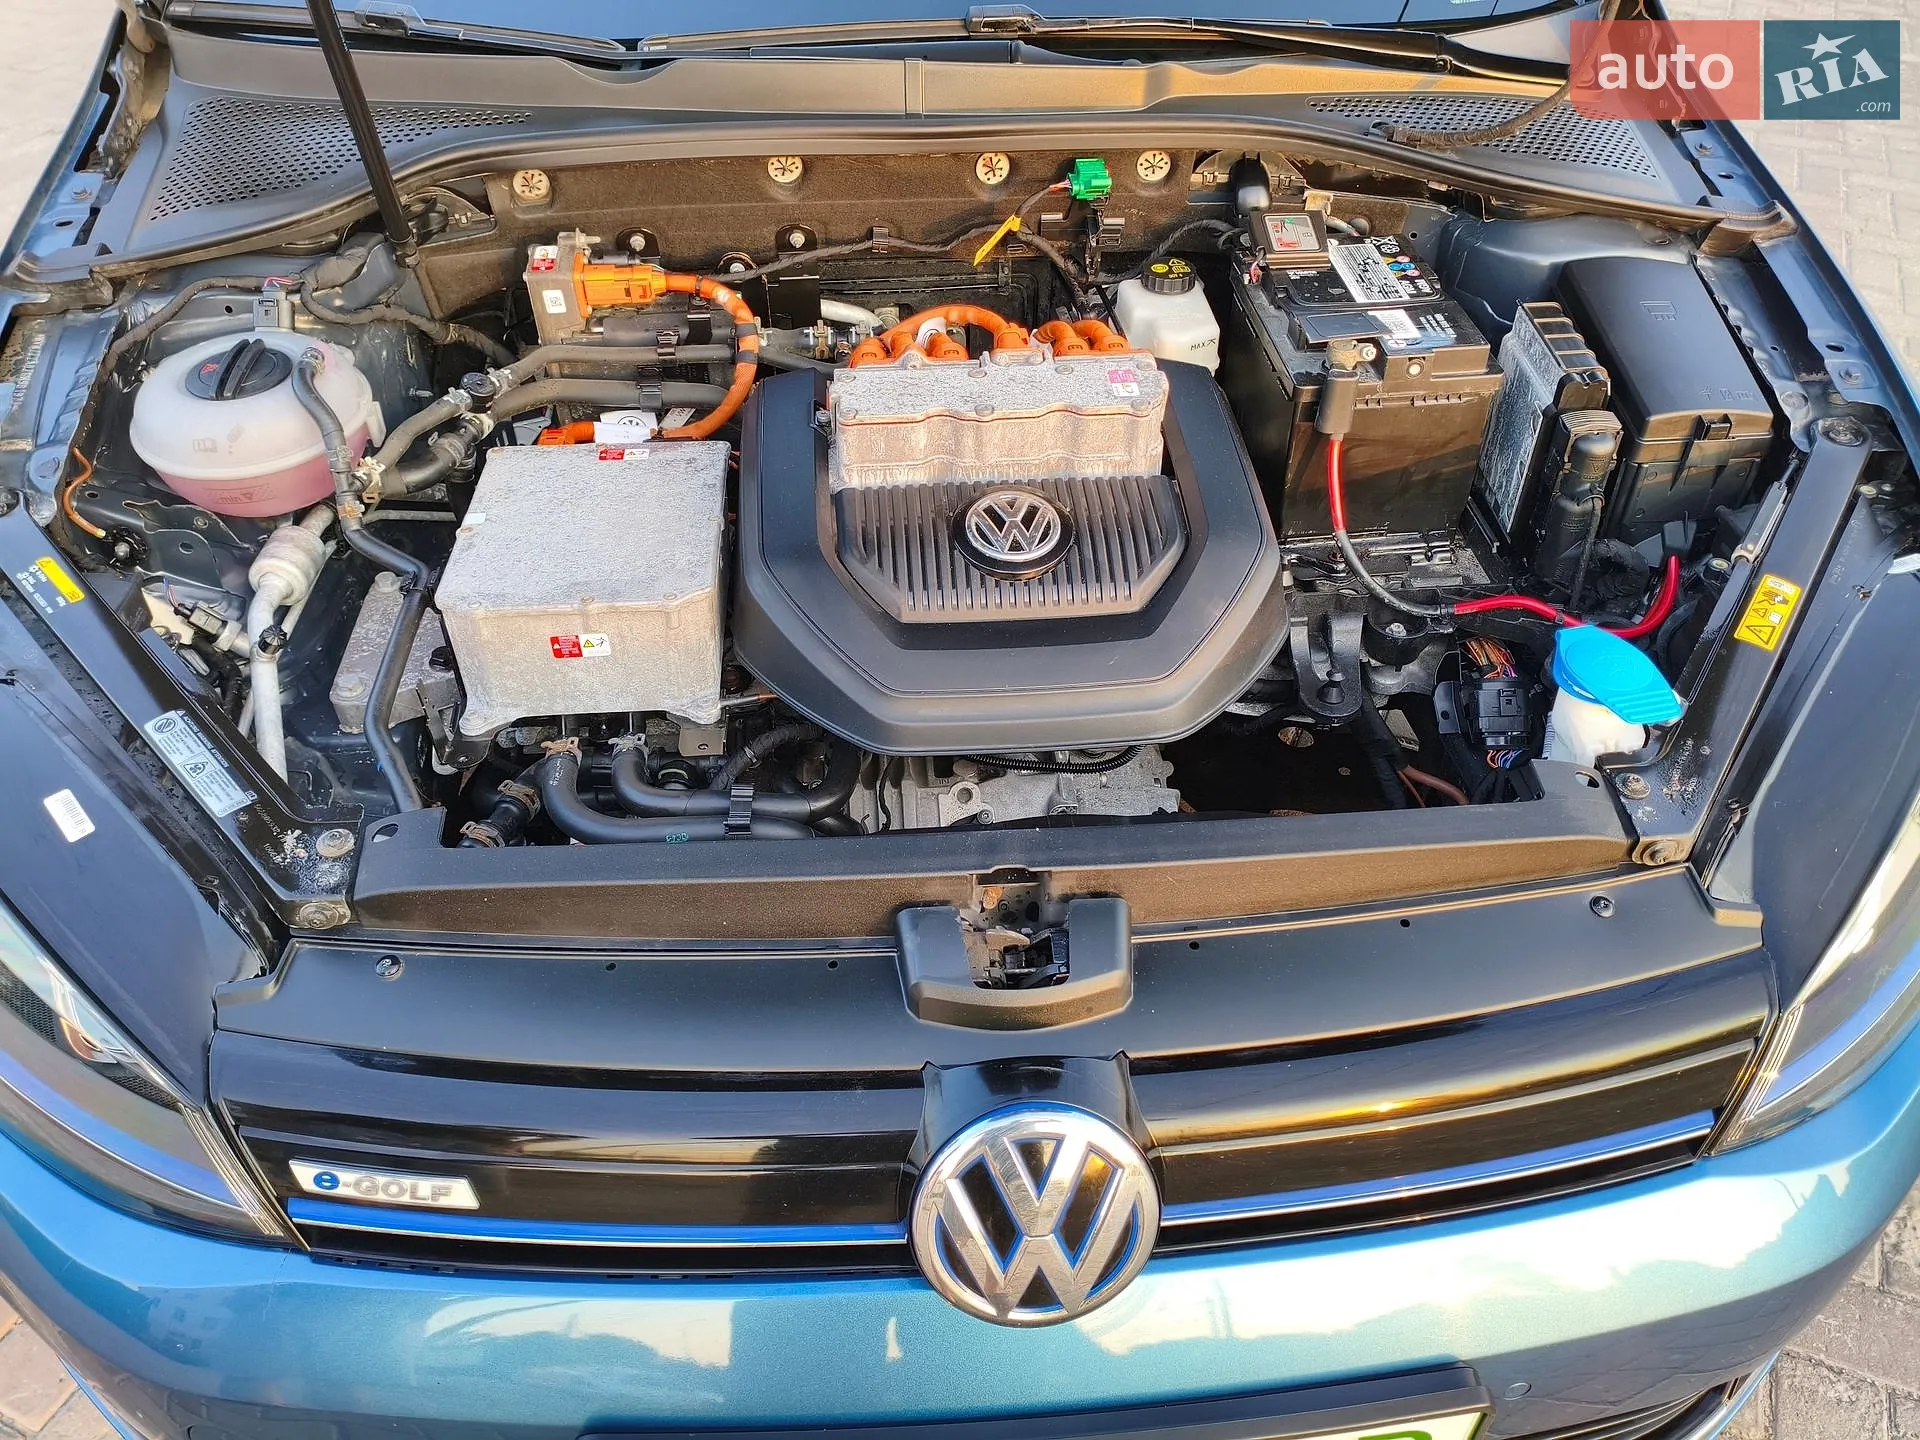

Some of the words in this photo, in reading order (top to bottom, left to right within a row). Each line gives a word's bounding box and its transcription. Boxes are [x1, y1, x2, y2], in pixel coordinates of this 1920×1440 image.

[1190, 341, 1206, 351] MAX
[312, 1170, 453, 1203] e-GOLF
[914, 1105, 1160, 1326] VW
